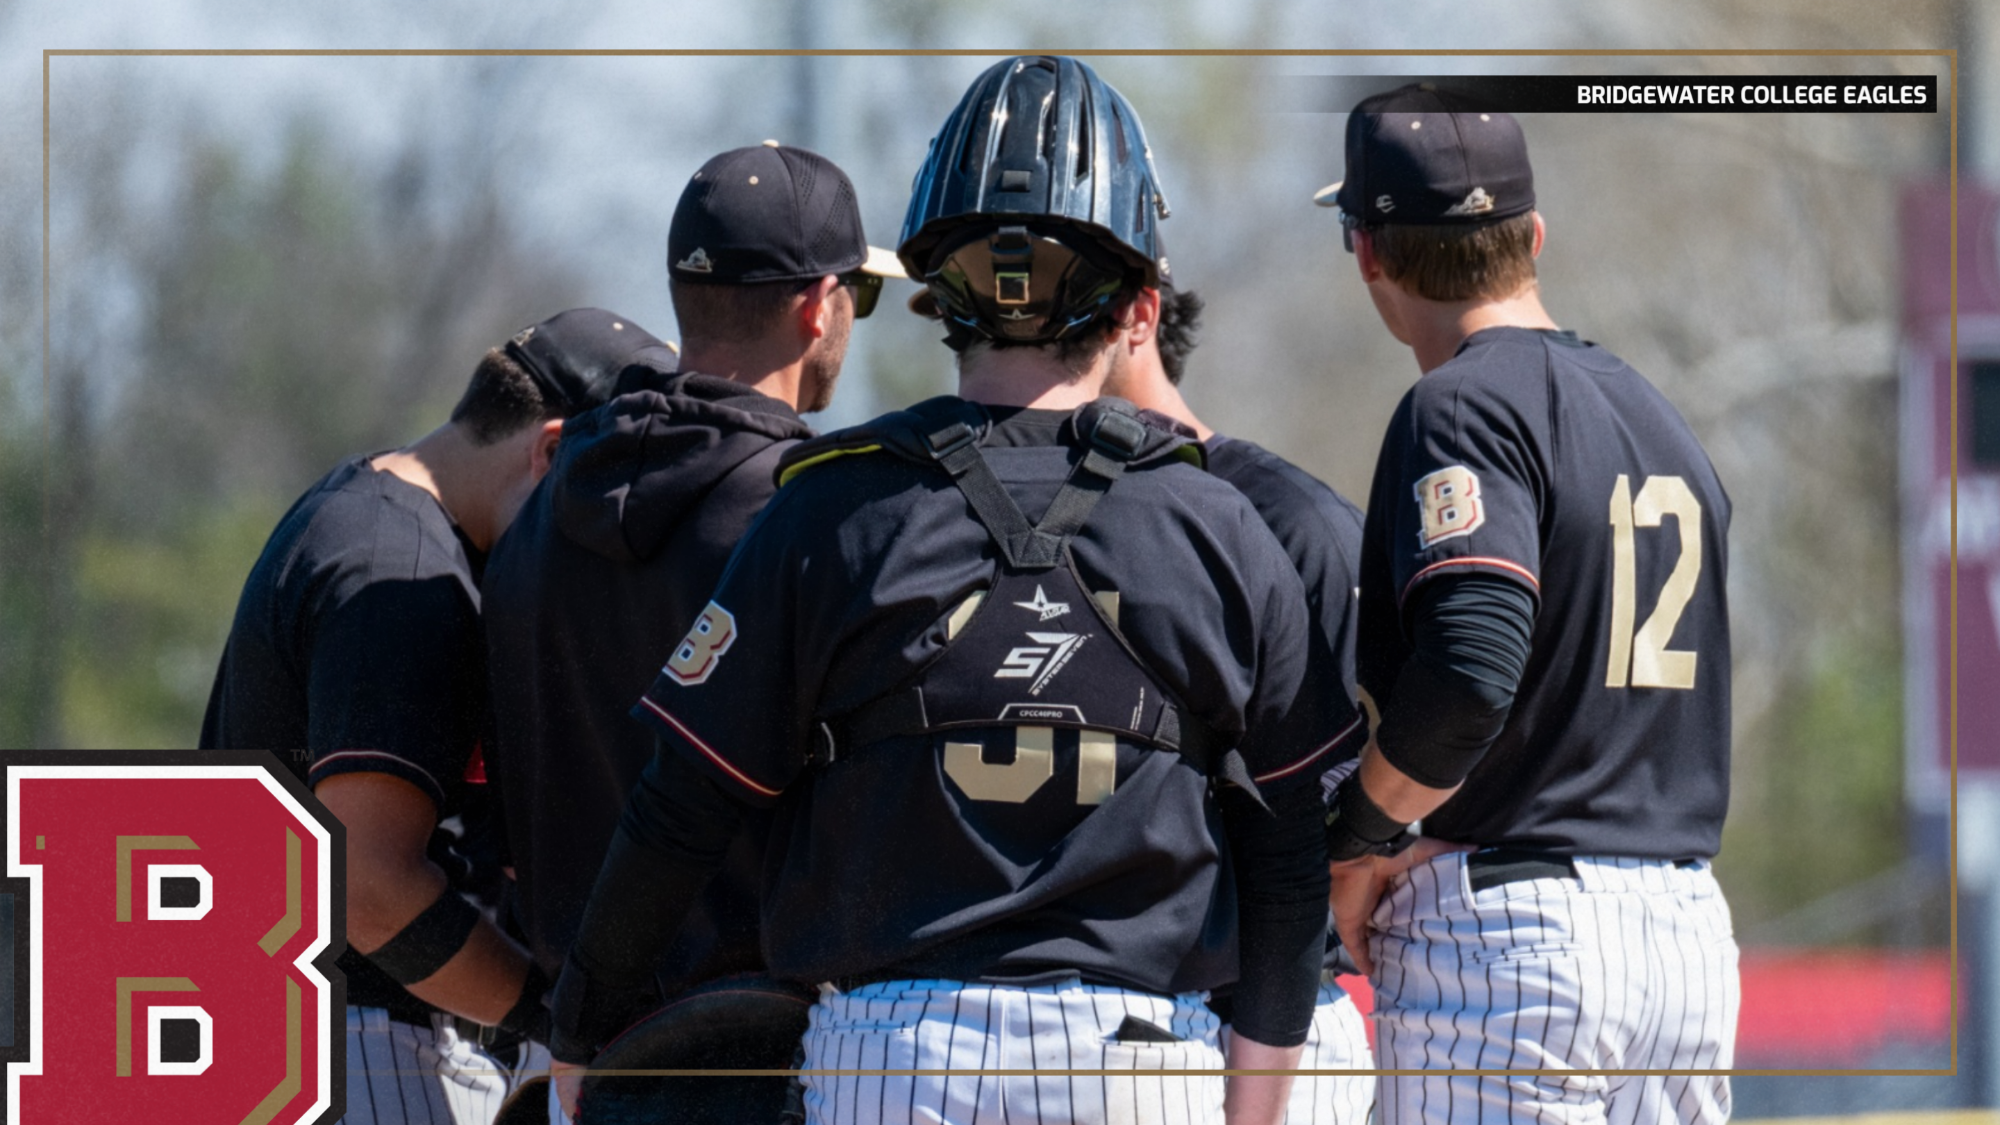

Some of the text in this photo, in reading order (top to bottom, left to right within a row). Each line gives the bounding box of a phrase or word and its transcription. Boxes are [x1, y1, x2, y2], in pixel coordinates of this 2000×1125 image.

[1413, 465, 1485, 550] B
[1605, 473, 1702, 690] 12
[662, 599, 737, 686] B
